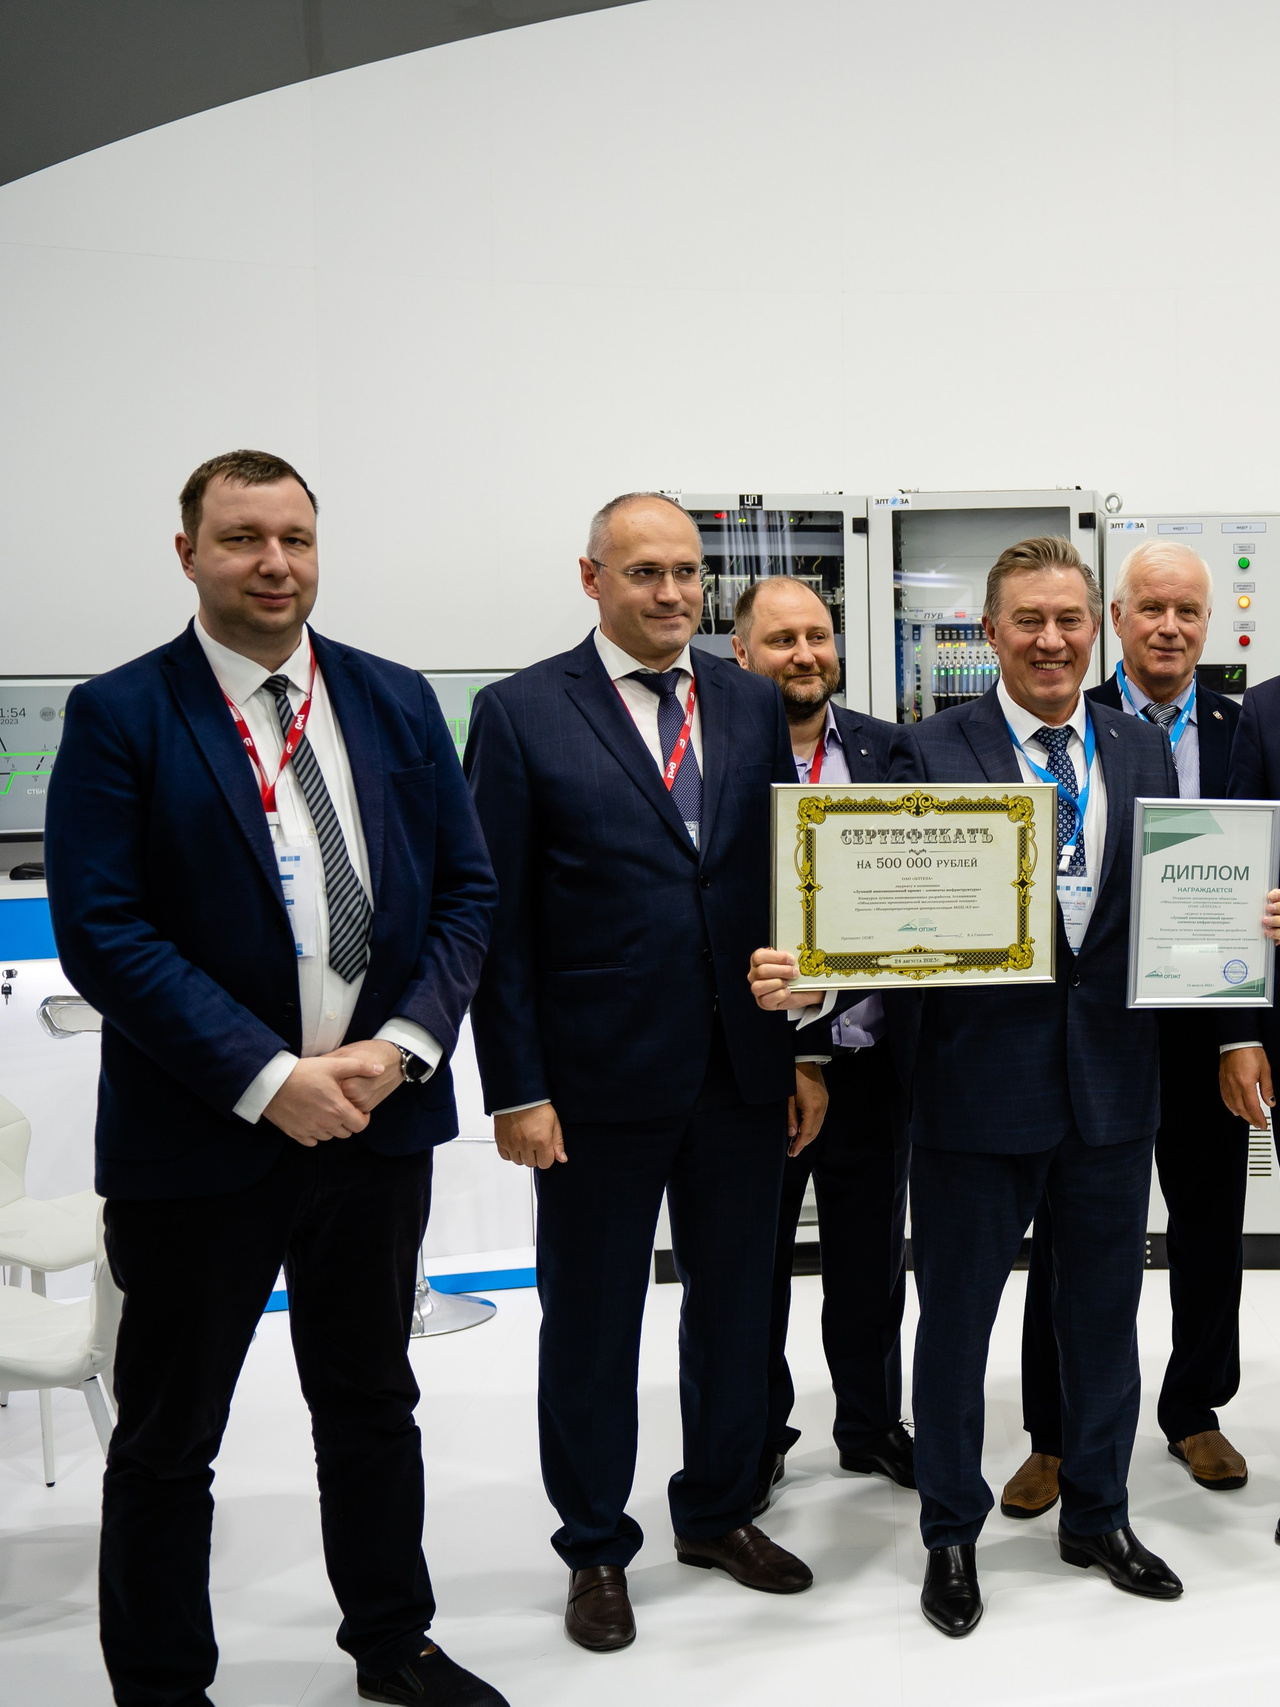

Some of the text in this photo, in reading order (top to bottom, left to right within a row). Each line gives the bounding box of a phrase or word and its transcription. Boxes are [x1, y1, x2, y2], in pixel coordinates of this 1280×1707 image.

[840, 828, 994, 845] СЕРТИФИКАТЪ
[857, 857, 978, 869] НА 500 000 РУБЛЕЙ
[1161, 864, 1250, 883] ДИПЛОМ
